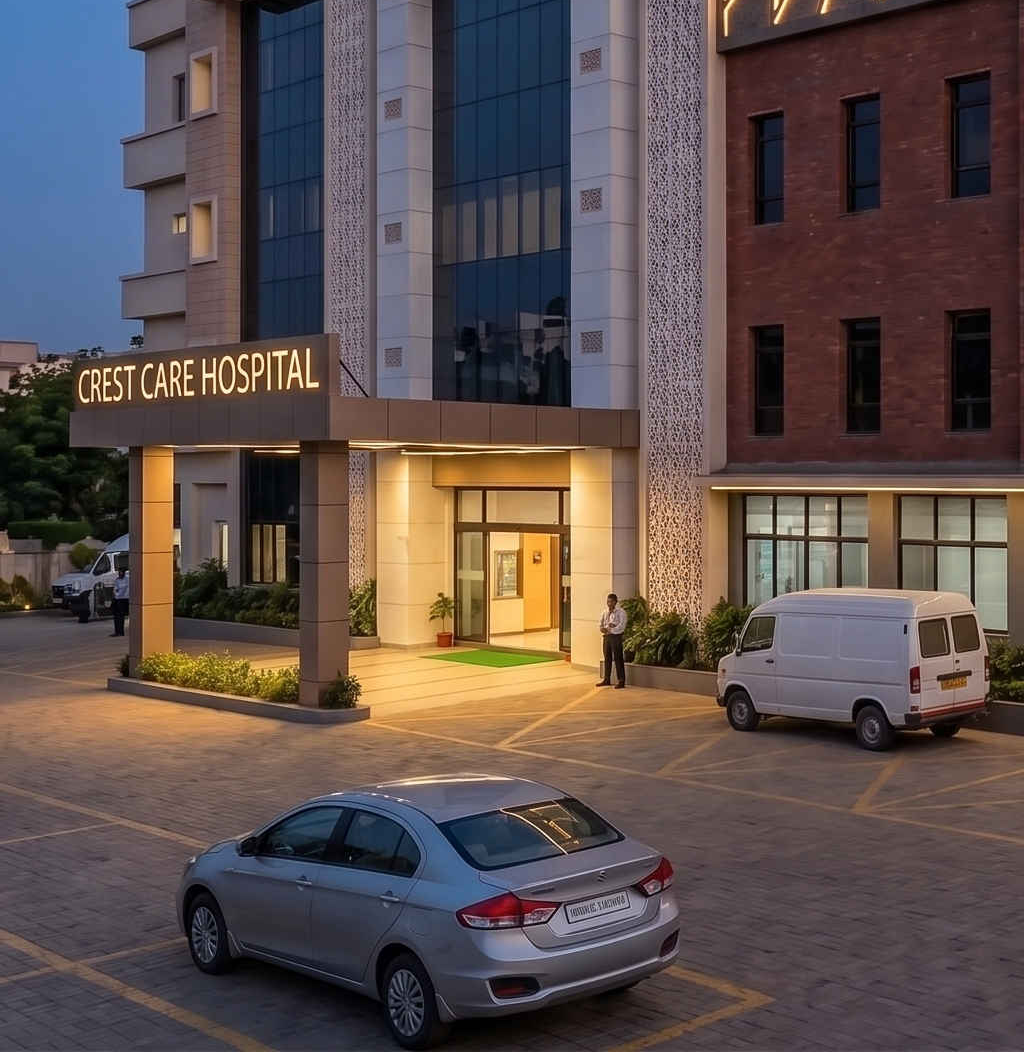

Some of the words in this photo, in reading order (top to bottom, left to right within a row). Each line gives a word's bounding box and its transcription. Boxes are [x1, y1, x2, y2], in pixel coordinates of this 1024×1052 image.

[78, 364, 136, 404] CREST
[140, 359, 195, 400] CARE
[202, 347, 320, 396] HOSPITAL
